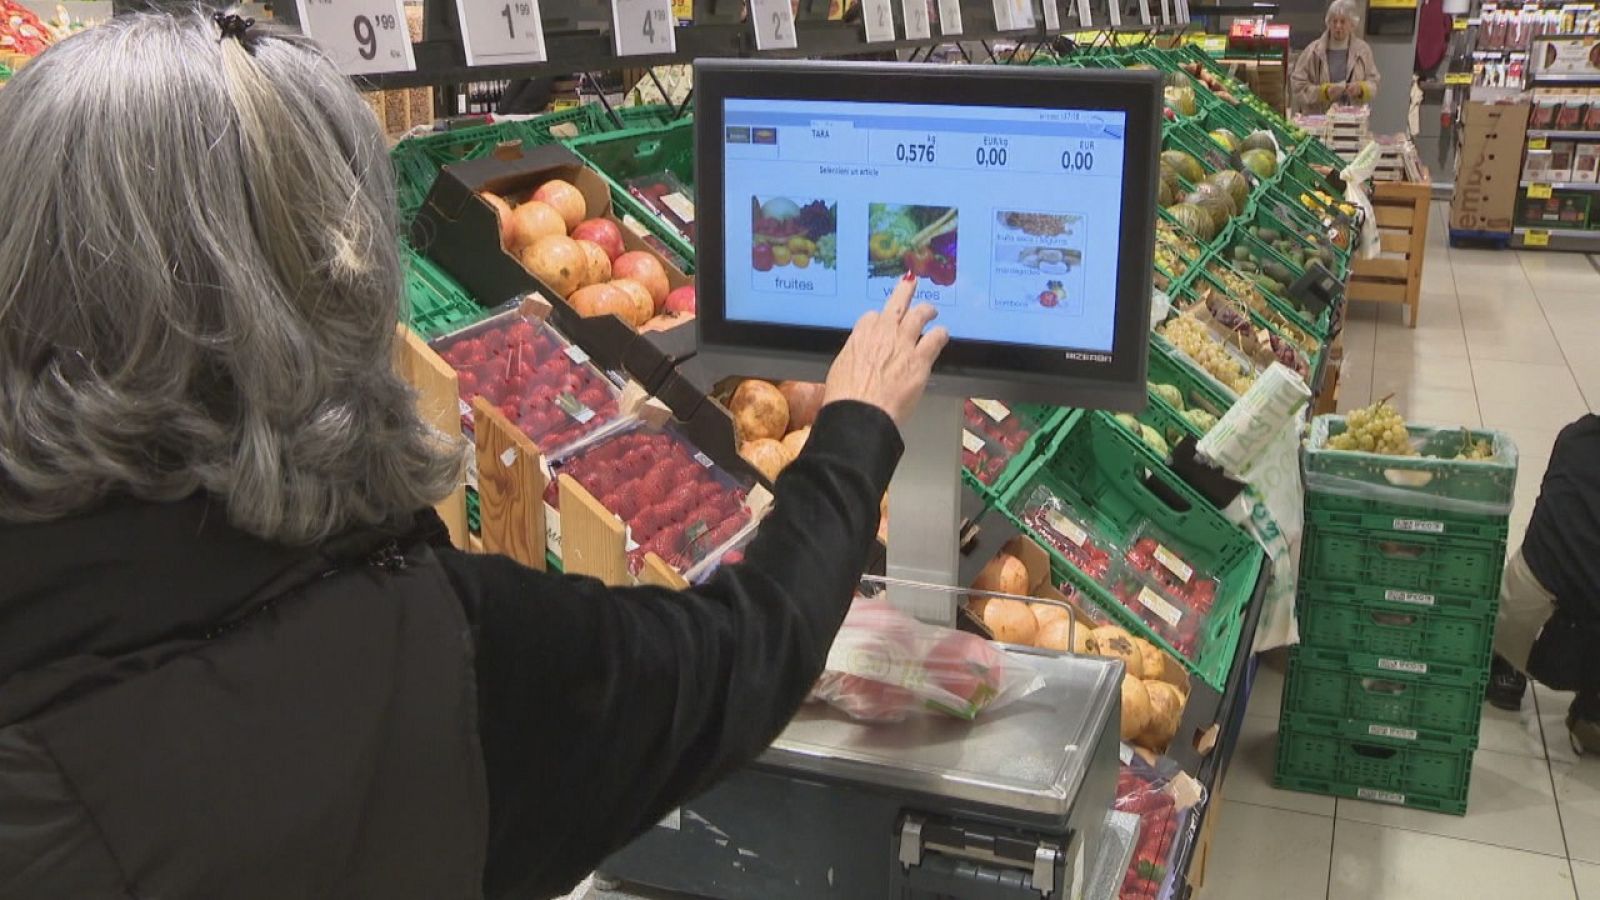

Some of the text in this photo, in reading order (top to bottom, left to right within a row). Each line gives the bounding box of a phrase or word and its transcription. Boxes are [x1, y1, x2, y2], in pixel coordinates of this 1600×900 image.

[812, 129, 829, 139] TARA
[1079, 140, 1095, 150] EUR
[896, 144, 935, 163] 0,576
[976, 147, 1007, 168] 0,00
[1061, 150, 1094, 172] 0,00
[775, 277, 814, 291] fruites
